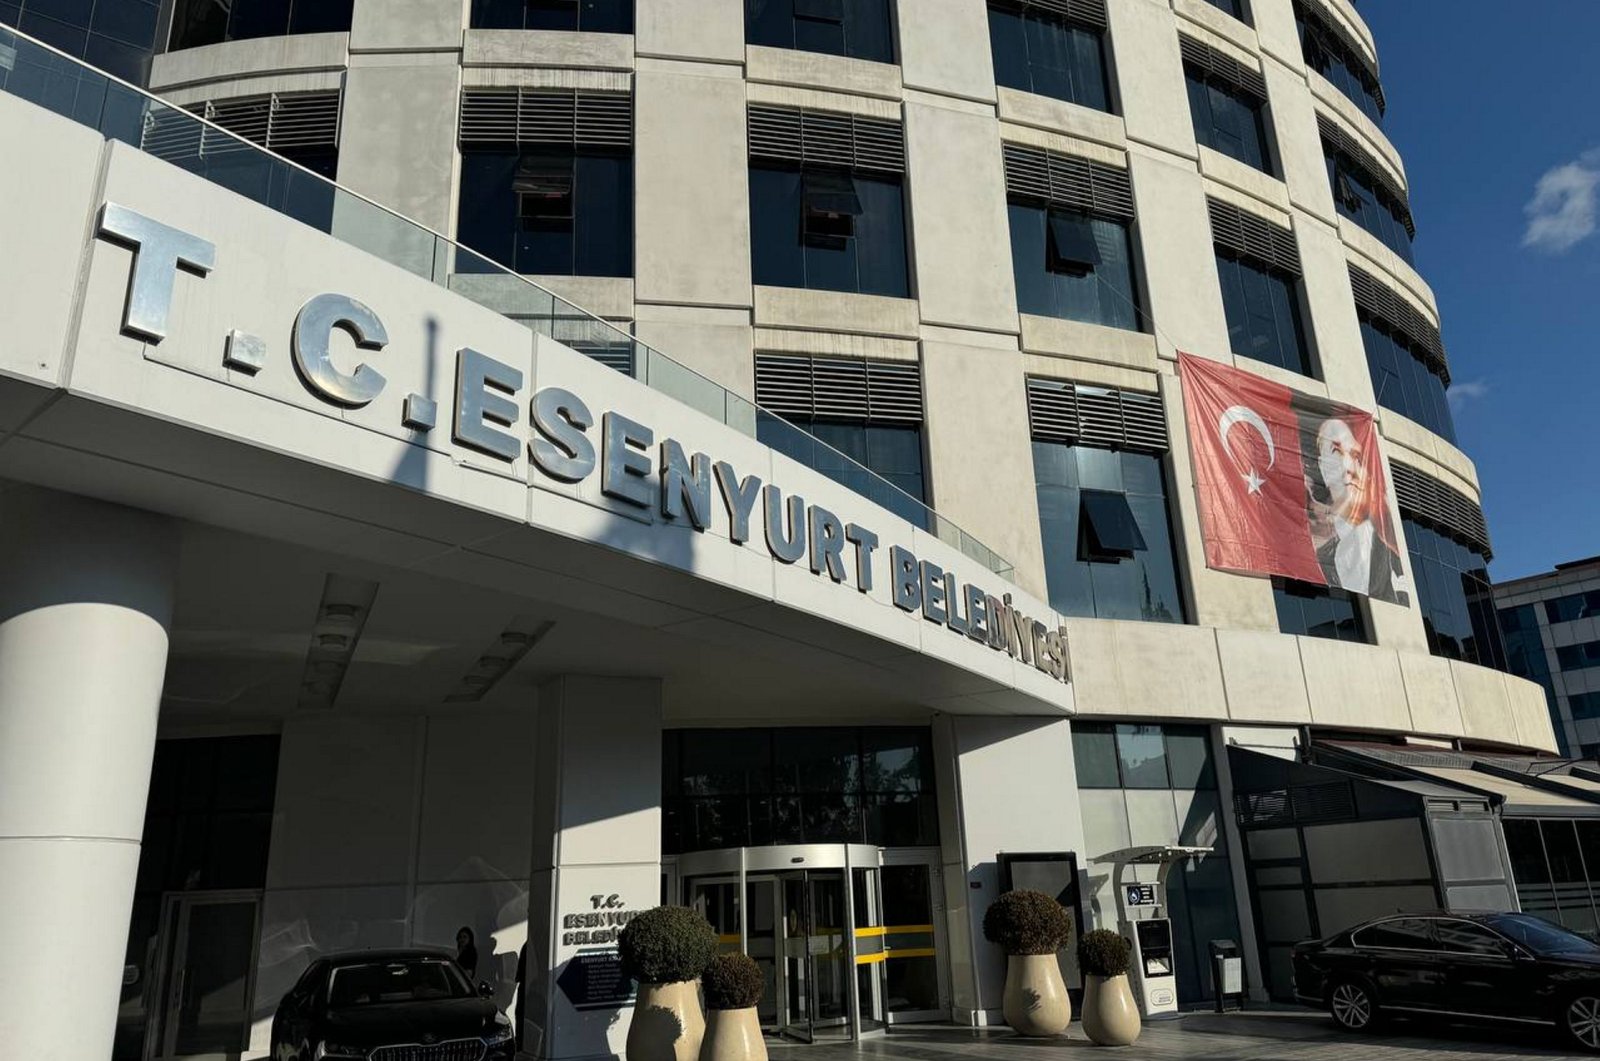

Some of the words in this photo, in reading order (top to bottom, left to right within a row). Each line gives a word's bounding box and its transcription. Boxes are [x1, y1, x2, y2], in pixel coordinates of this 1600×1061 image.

[97, 201, 437, 432] T.C.
[451, 347, 878, 593] ESENYURT
[889, 545, 1071, 684] BELEDİYESİ
[590, 894, 625, 909] T.C.
